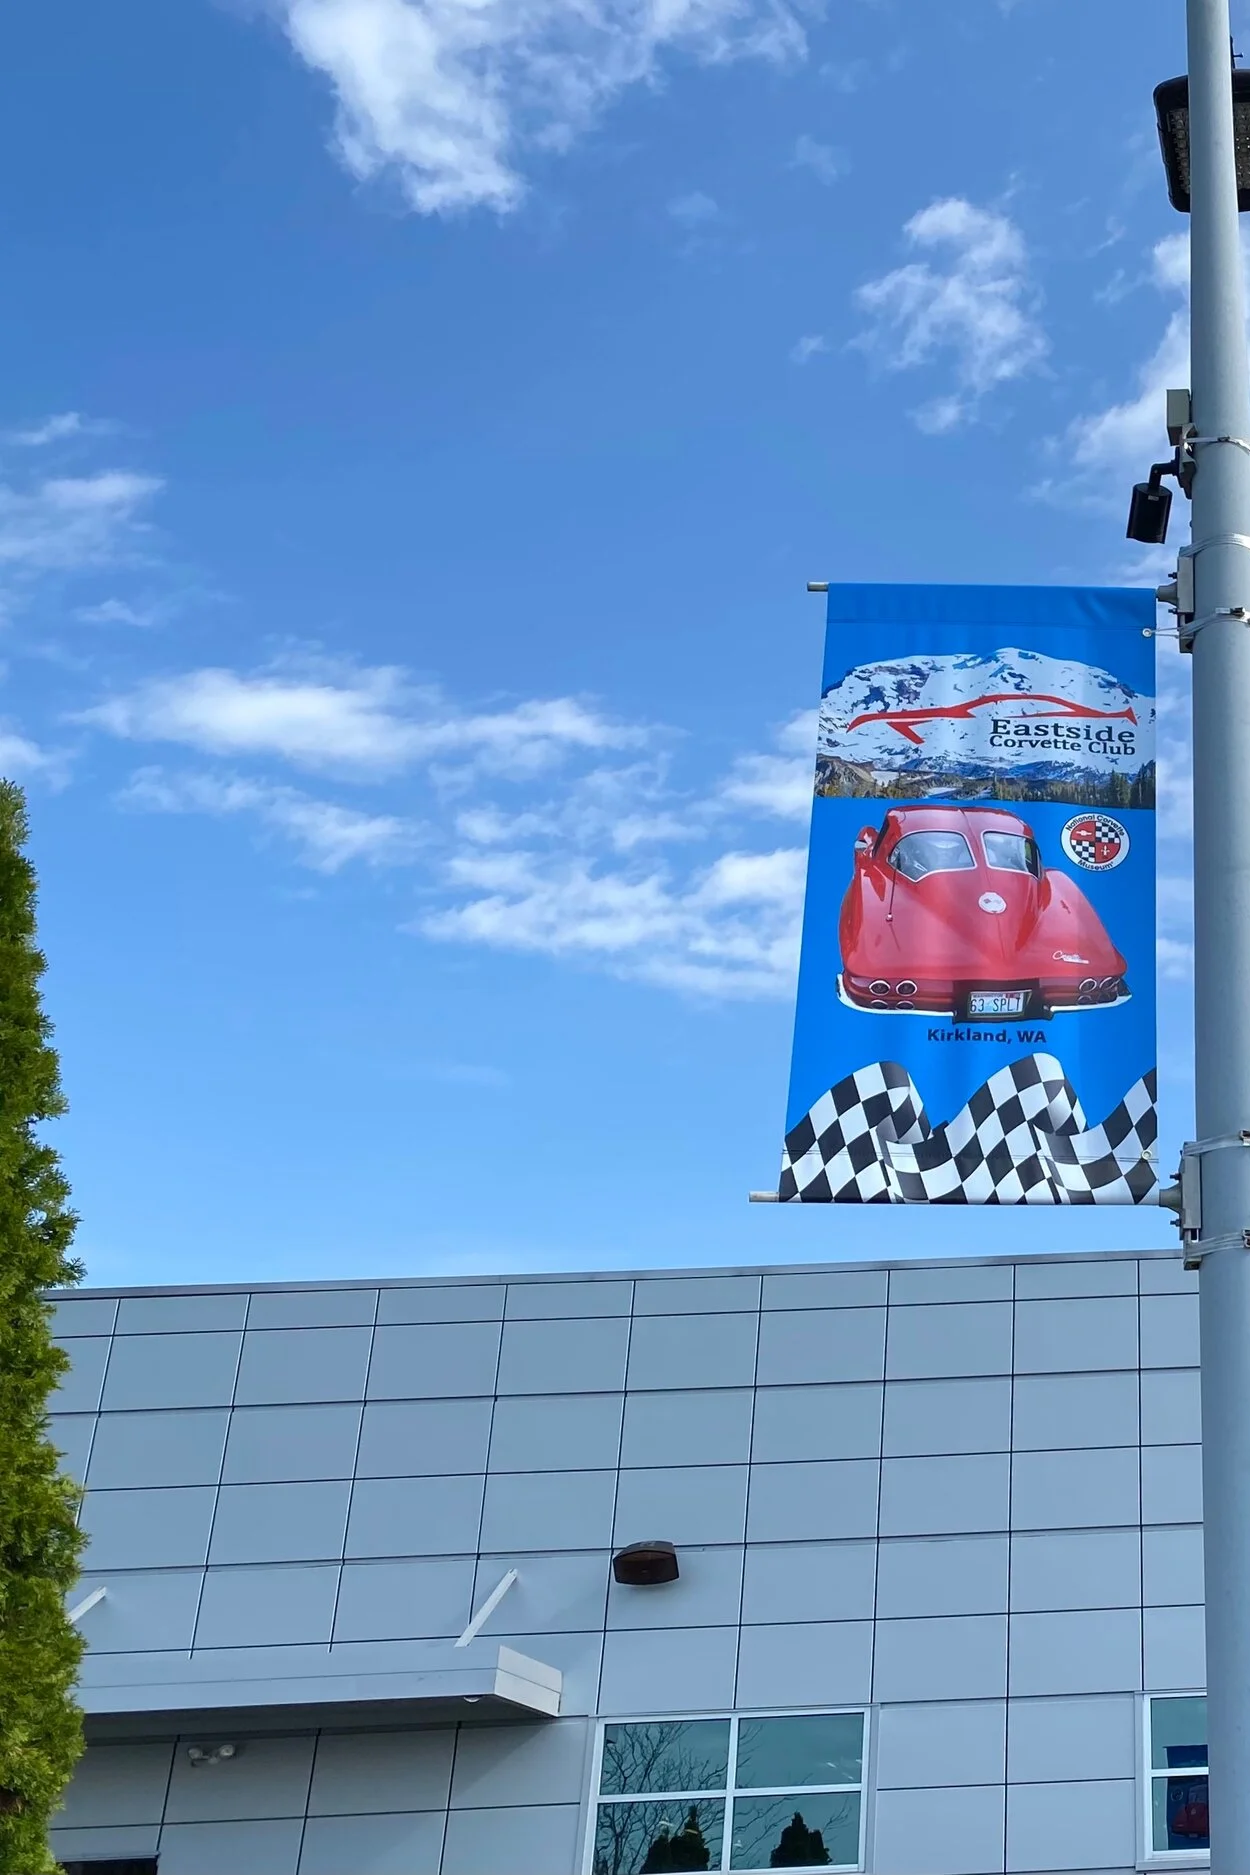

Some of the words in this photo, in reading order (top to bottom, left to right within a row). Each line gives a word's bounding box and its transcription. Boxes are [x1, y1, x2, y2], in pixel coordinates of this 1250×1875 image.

[990, 719, 1135, 742] Eastside
[989, 735, 1082, 751] Corvette
[1088, 741, 1136, 755] Club
[1065, 815, 1095, 831] National
[1097, 815, 1125, 836] Corvette
[970, 998, 985, 1012] 63
[993, 997, 1021, 1011] SPLT
[927, 1028, 1012, 1044] Kirkland,
[1017, 1030, 1046, 1043] WA
